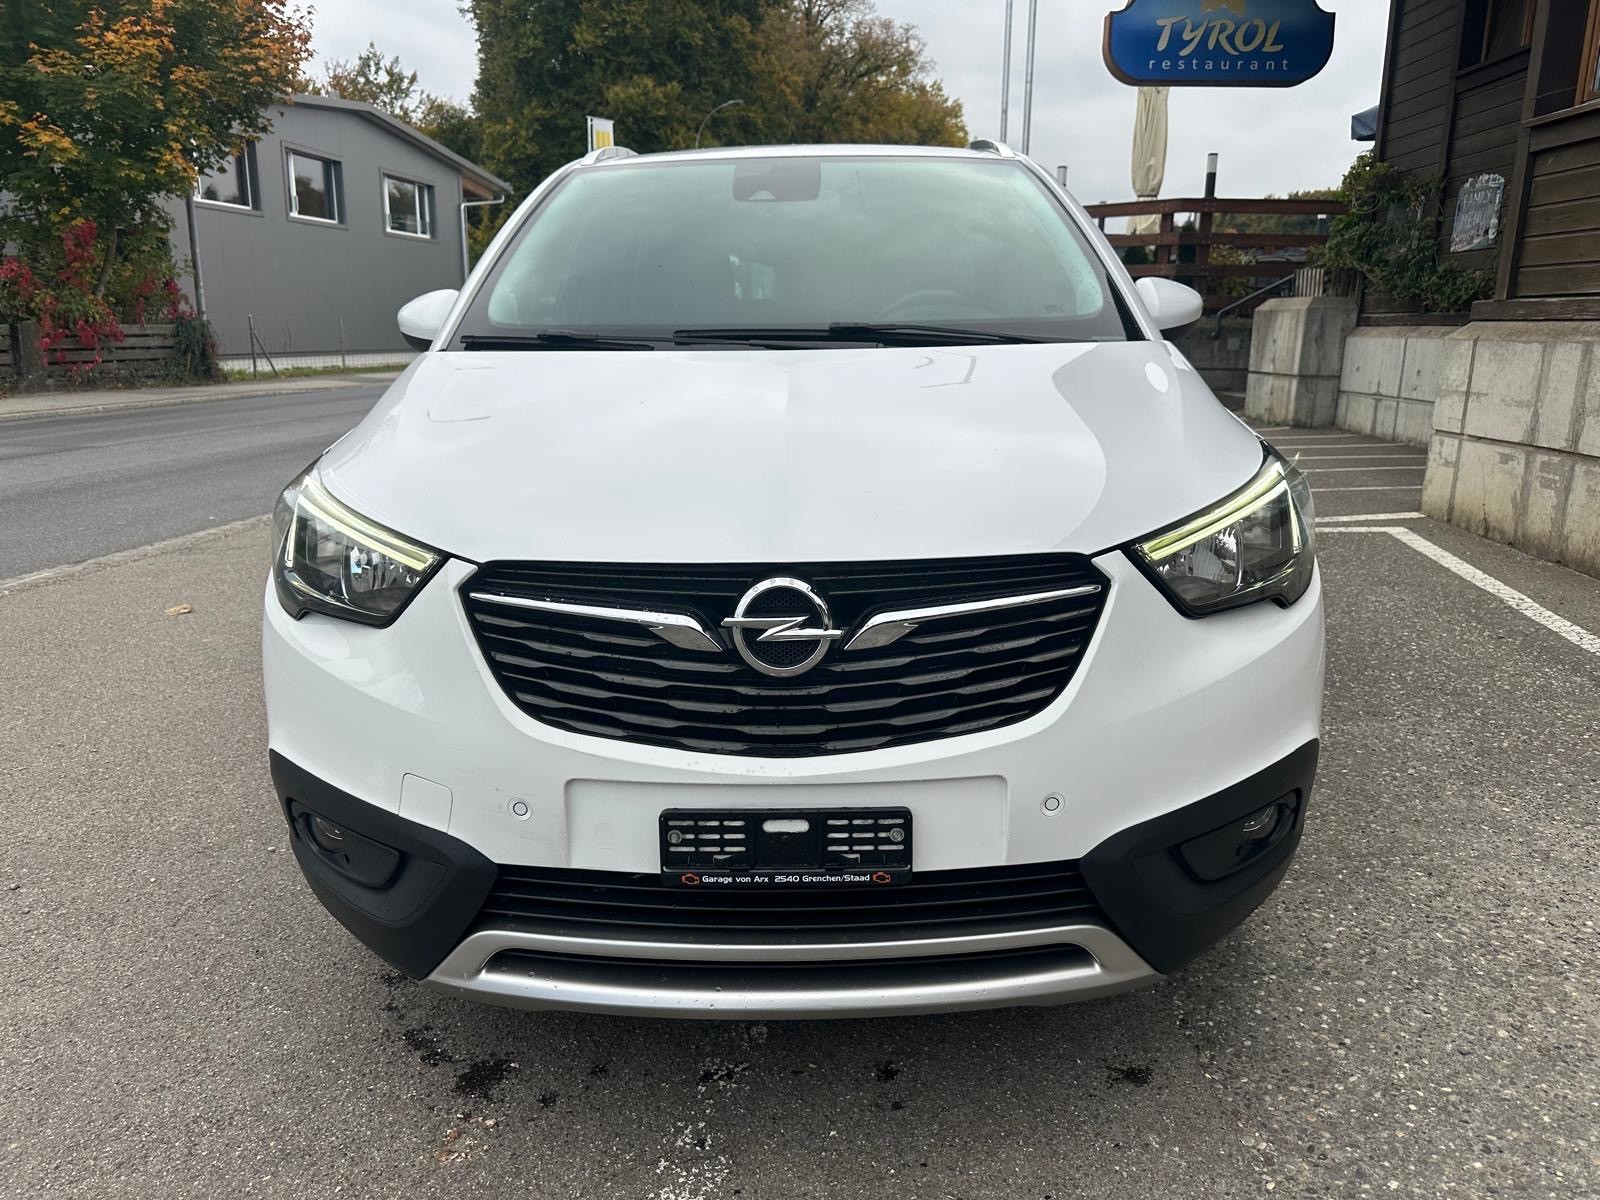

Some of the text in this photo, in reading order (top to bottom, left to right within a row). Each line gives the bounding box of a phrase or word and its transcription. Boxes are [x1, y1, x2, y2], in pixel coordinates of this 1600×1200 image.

[1155, 15, 1284, 57] TYROL
[1148, 58, 1289, 71] restaurant
[702, 875, 733, 884] Garage
[753, 875, 769, 883] Arx
[774, 875, 800, 883] 2540
[802, 874, 870, 883] Grenchen/Staad
